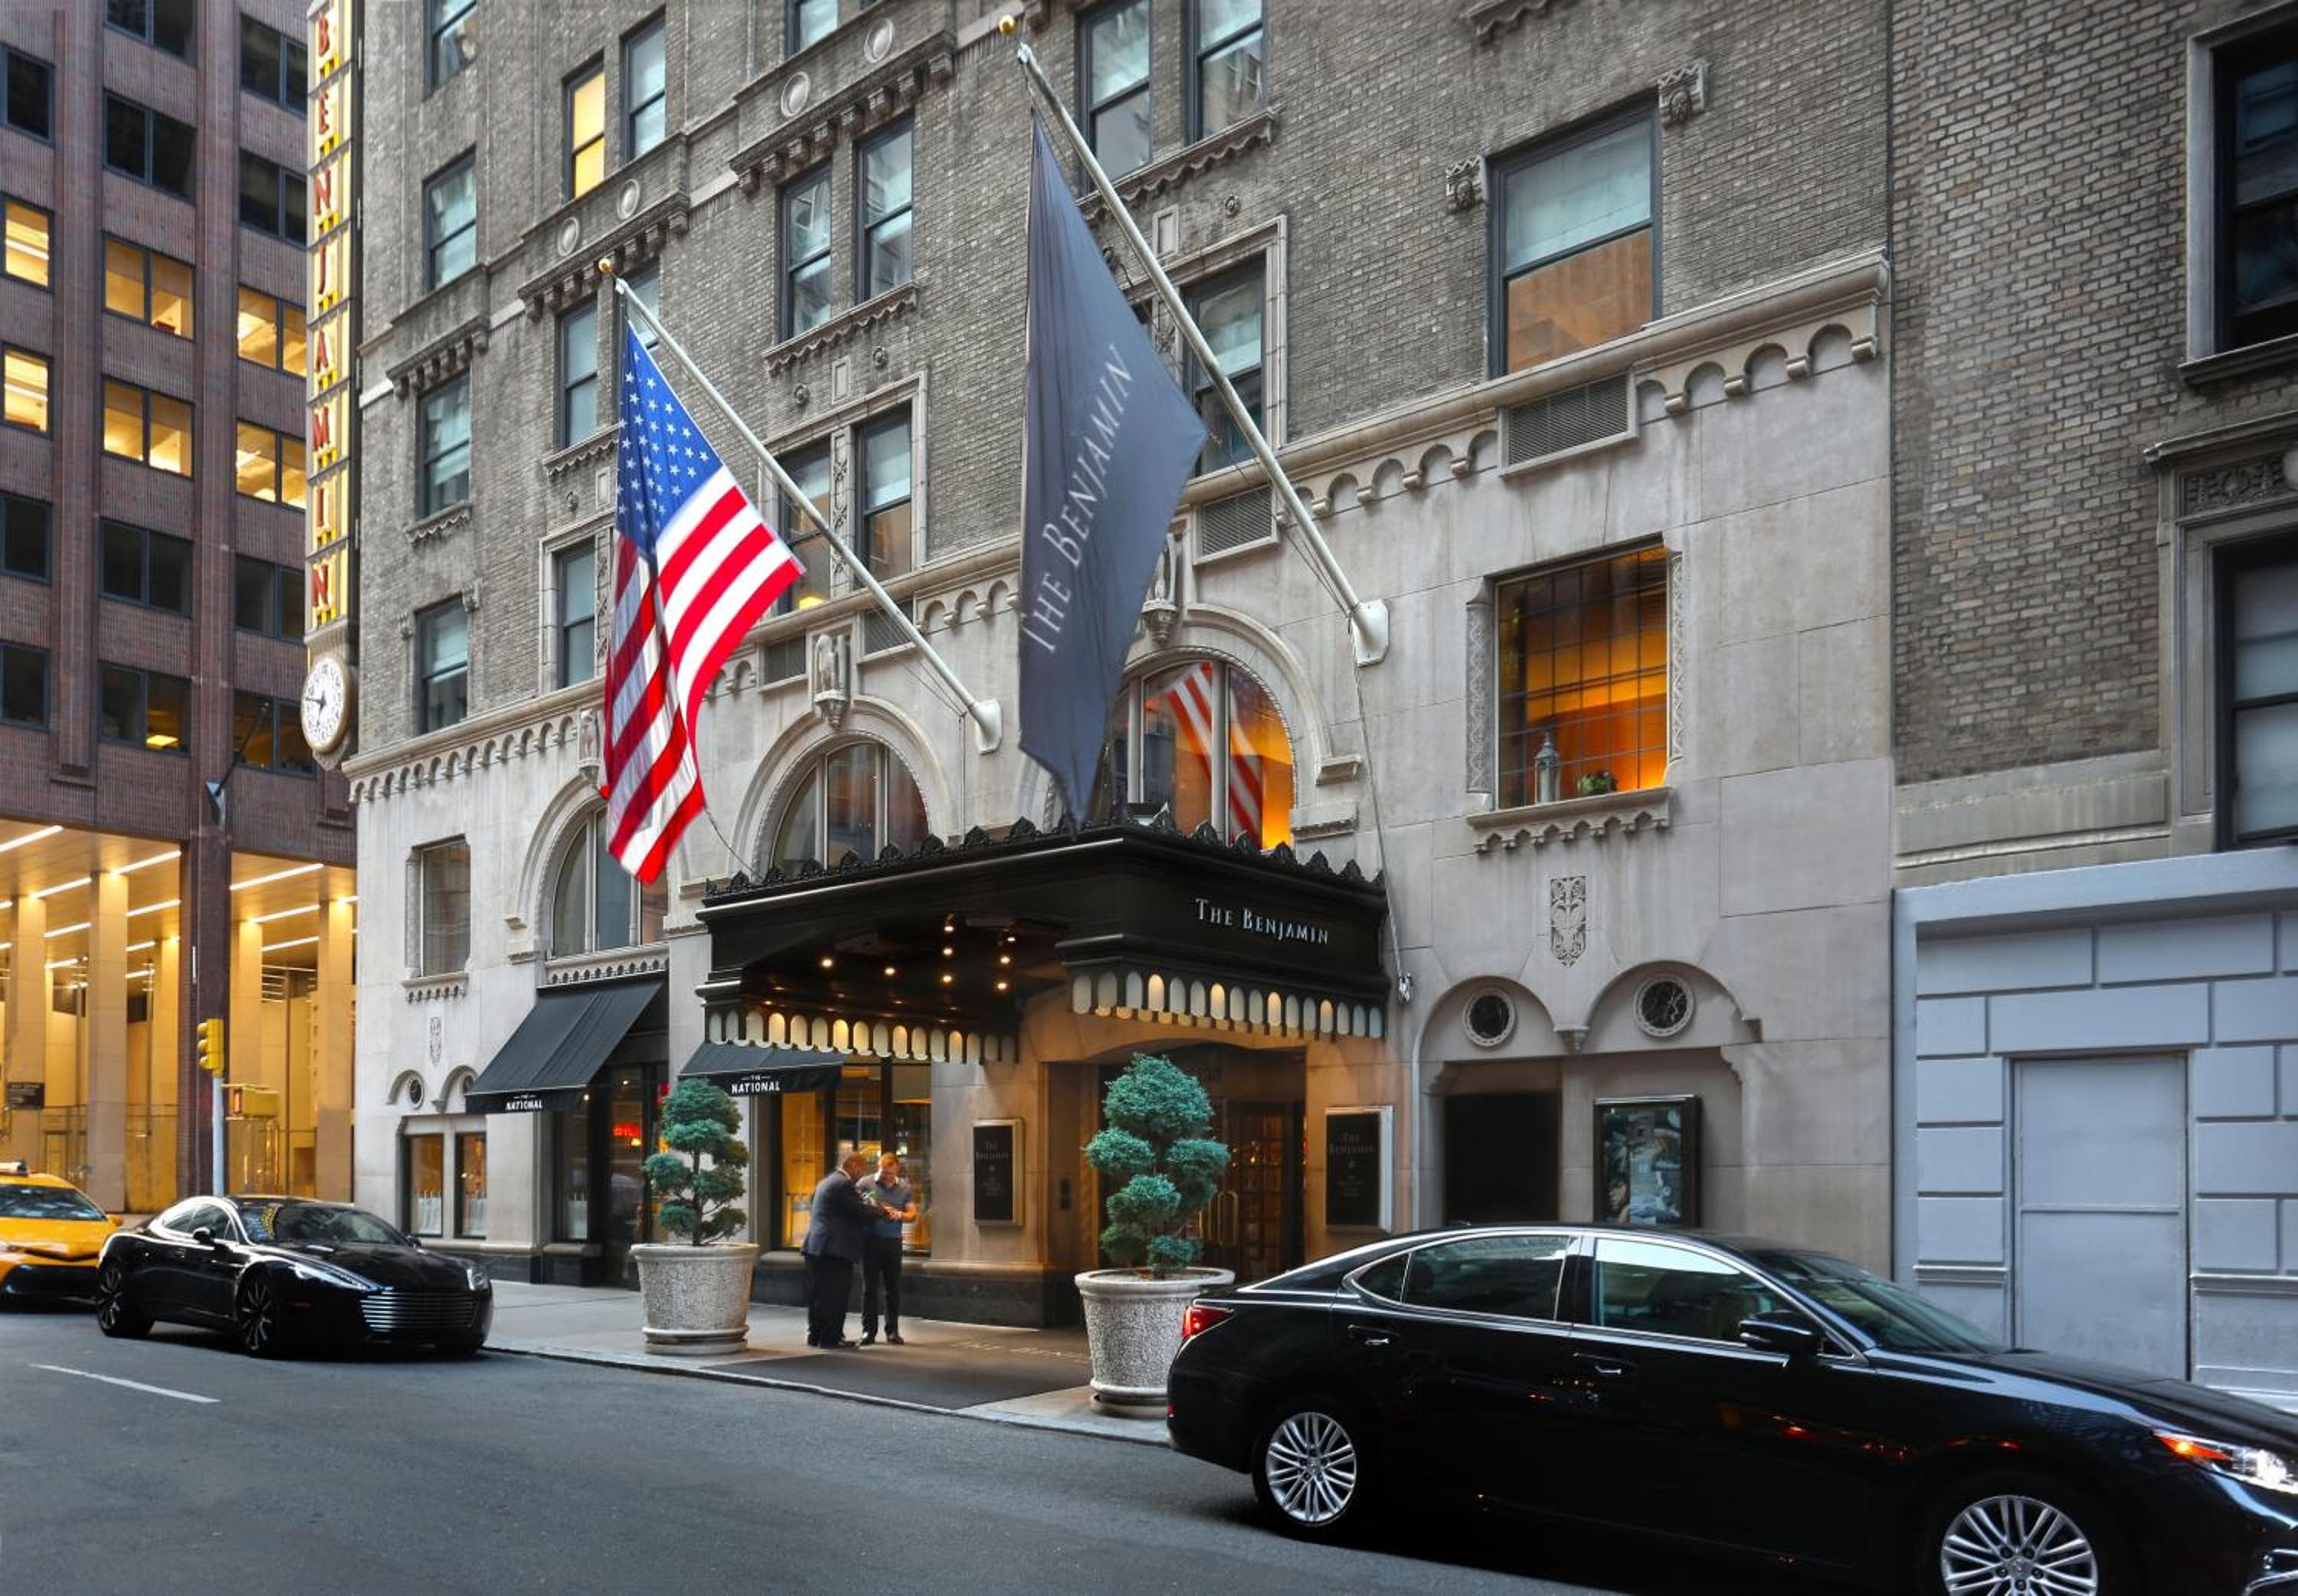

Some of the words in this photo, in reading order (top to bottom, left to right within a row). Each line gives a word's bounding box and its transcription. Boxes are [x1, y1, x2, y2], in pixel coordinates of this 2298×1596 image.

[311, 15, 332, 608] BENJAMIN
[1042, 343, 1133, 569] BENJAMIN
[1020, 571, 1072, 654] THE
[1195, 898, 1232, 927] THE
[1242, 907, 1328, 944] BENJAMIN
[506, 1099, 543, 1110] NATIONAL
[732, 1081, 781, 1094] NATIONAL
